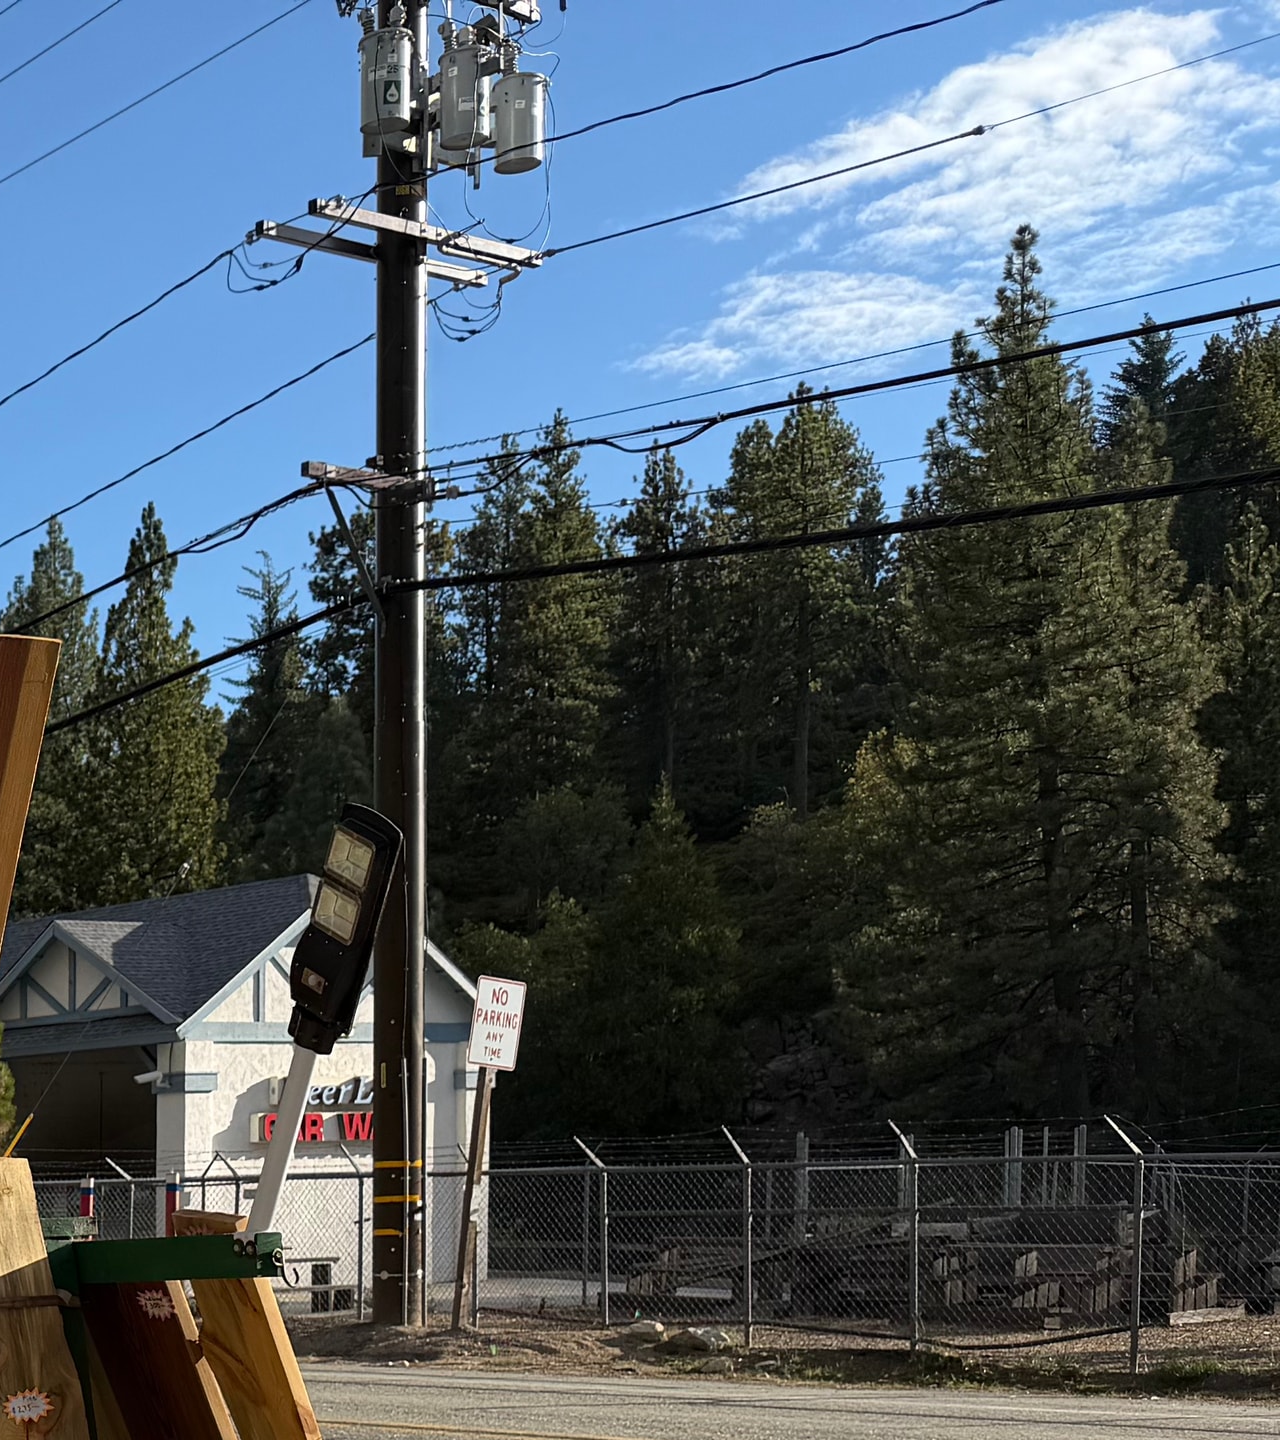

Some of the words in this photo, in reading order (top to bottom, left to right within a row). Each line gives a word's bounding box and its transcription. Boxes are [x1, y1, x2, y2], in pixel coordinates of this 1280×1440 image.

[491, 987, 509, 1006] NO
[475, 1008, 519, 1029] PARKING
[485, 1031, 504, 1043] ANY
[483, 1046, 503, 1059] TIME
